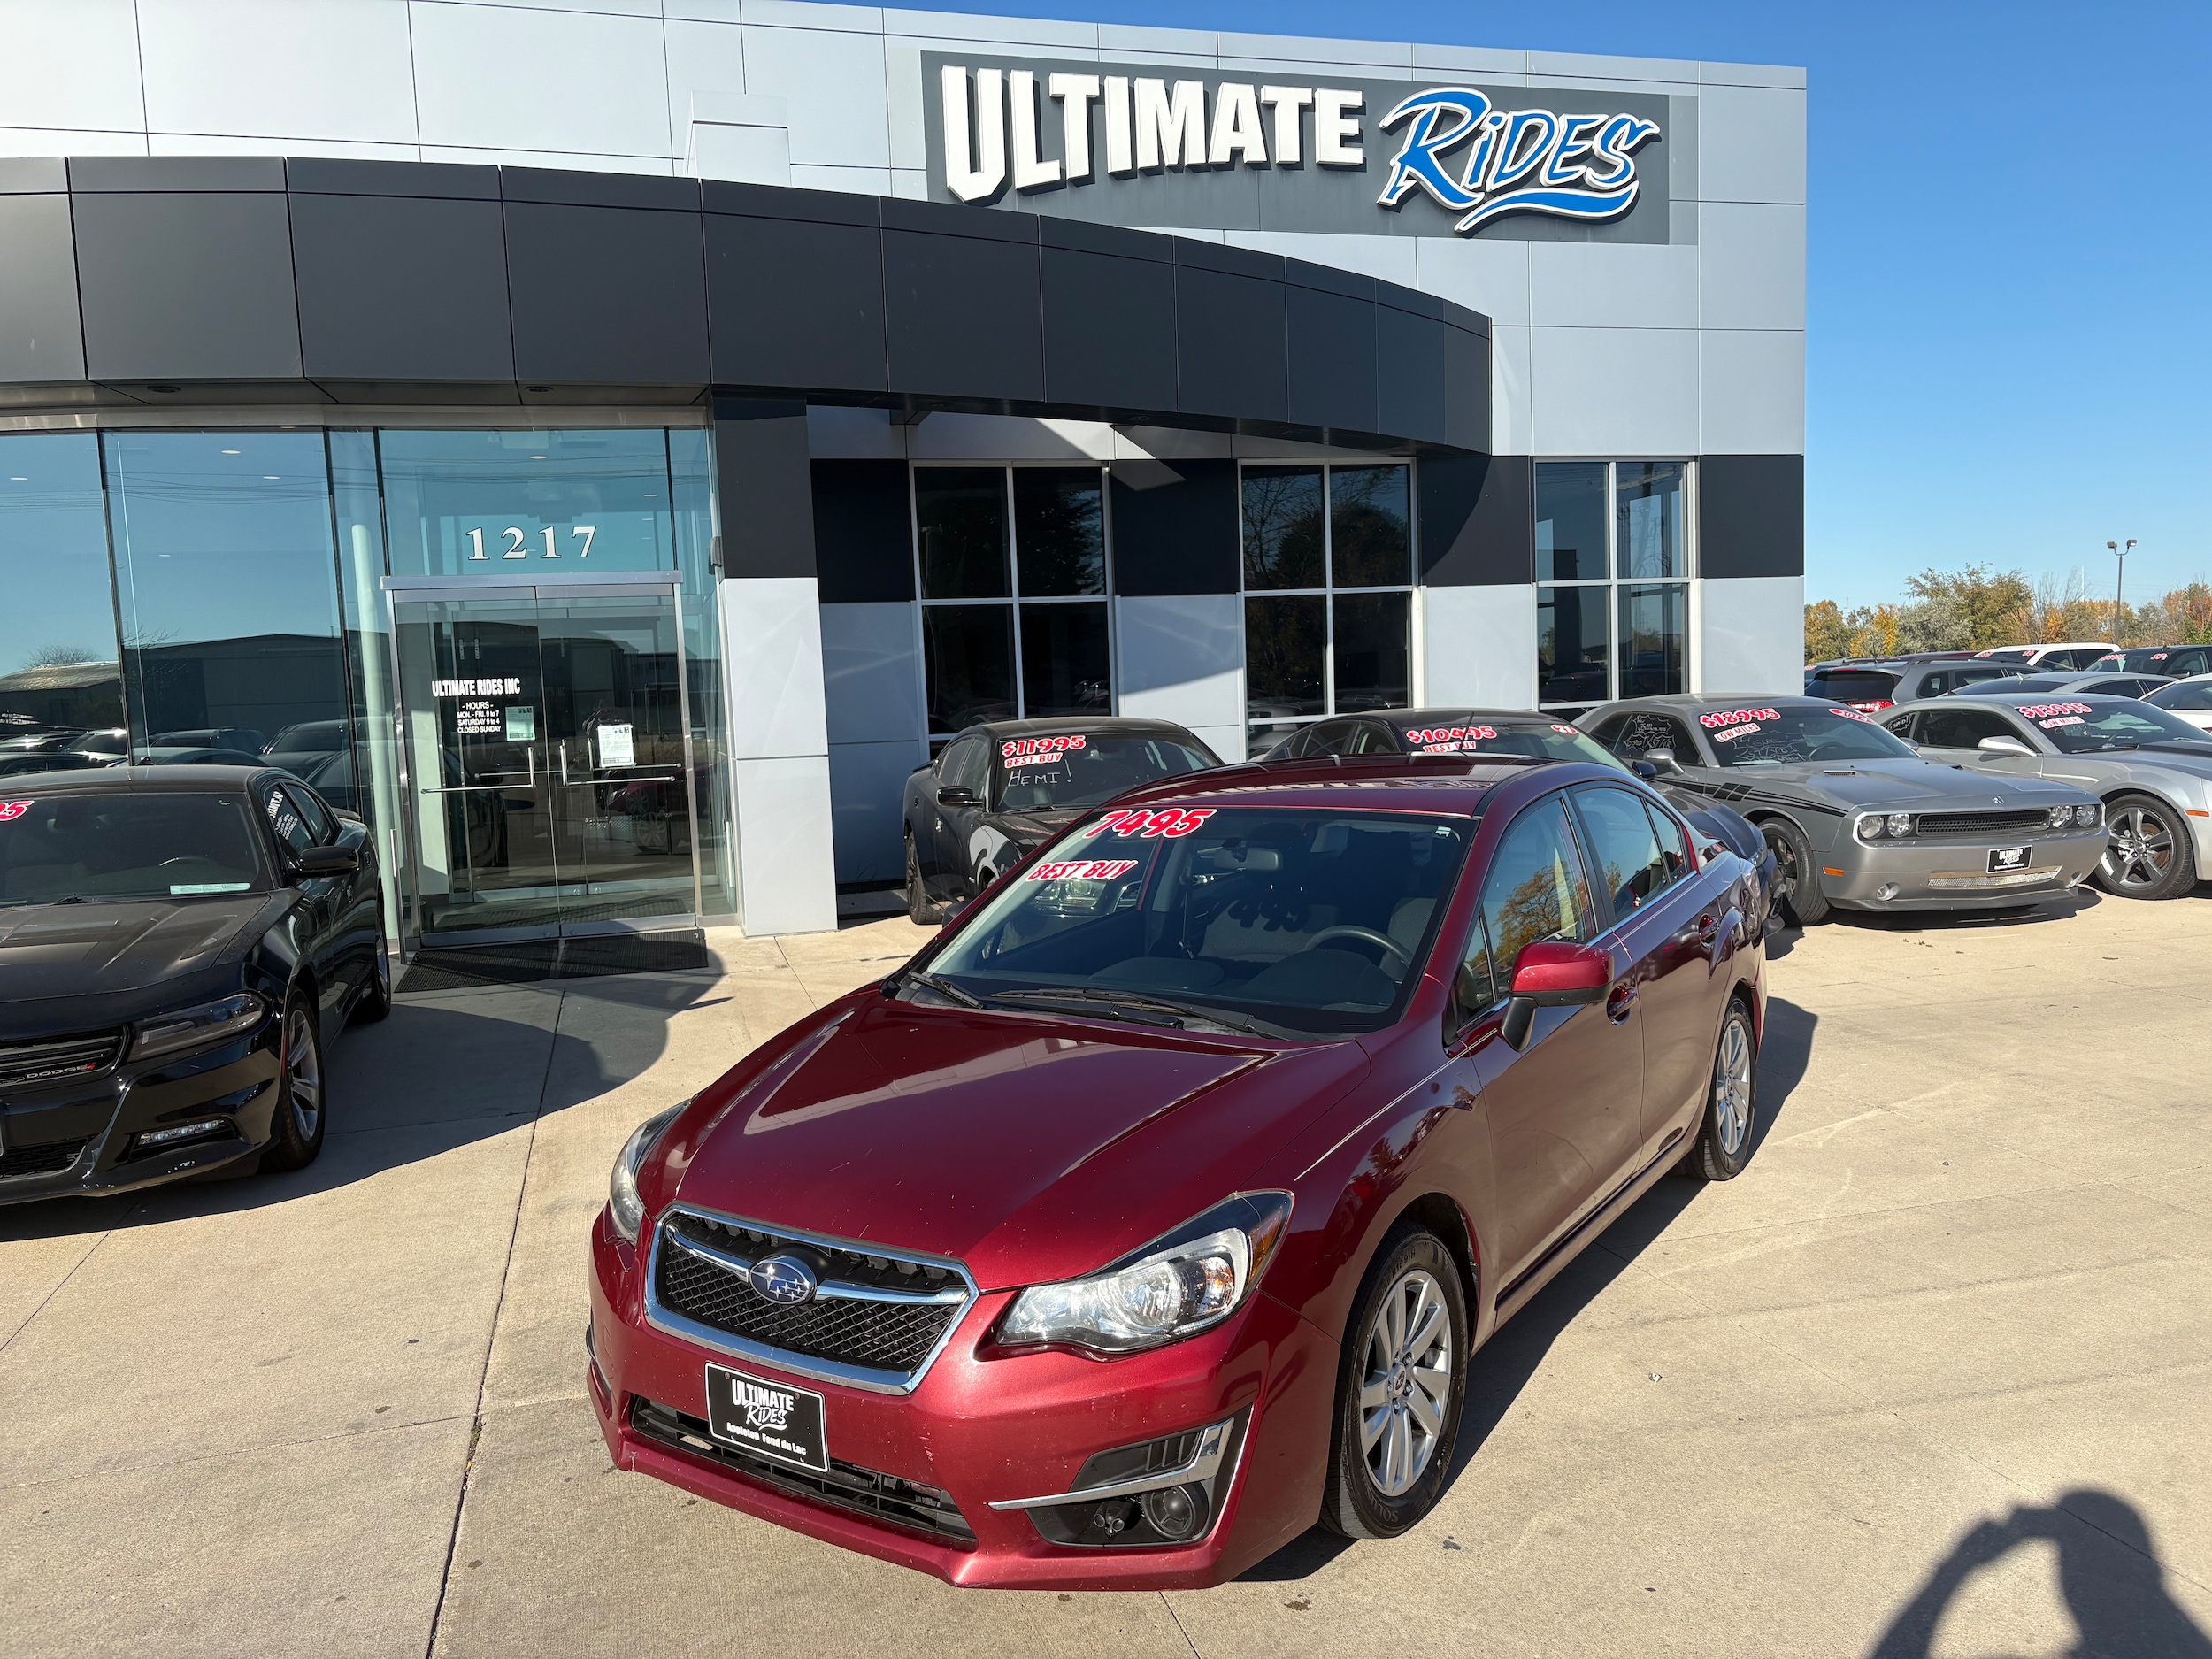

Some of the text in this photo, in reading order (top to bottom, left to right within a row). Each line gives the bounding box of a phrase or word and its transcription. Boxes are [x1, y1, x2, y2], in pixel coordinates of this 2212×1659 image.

[941, 65, 1364, 204] ULTIMATE
[466, 526, 596, 560] 1217
[432, 678, 520, 697] ULTIMATE RIDES INC
[1700, 708, 1781, 728] $18995
[2019, 702, 2093, 718] $13995
[1406, 726, 1497, 743] $10495
[1716, 724, 1760, 741] LOW MILES
[1002, 735, 1087, 757] $11995
[1005, 752, 1063, 768] BEST BUY
[1081, 808, 1217, 839] 7495
[1026, 860, 1138, 881] BEST BUY
[26, 1065, 84, 1079] DODGE
[732, 1379, 795, 1411] ULTIMATE
[726, 1422, 807, 1455] Appleton Fond du Lac
